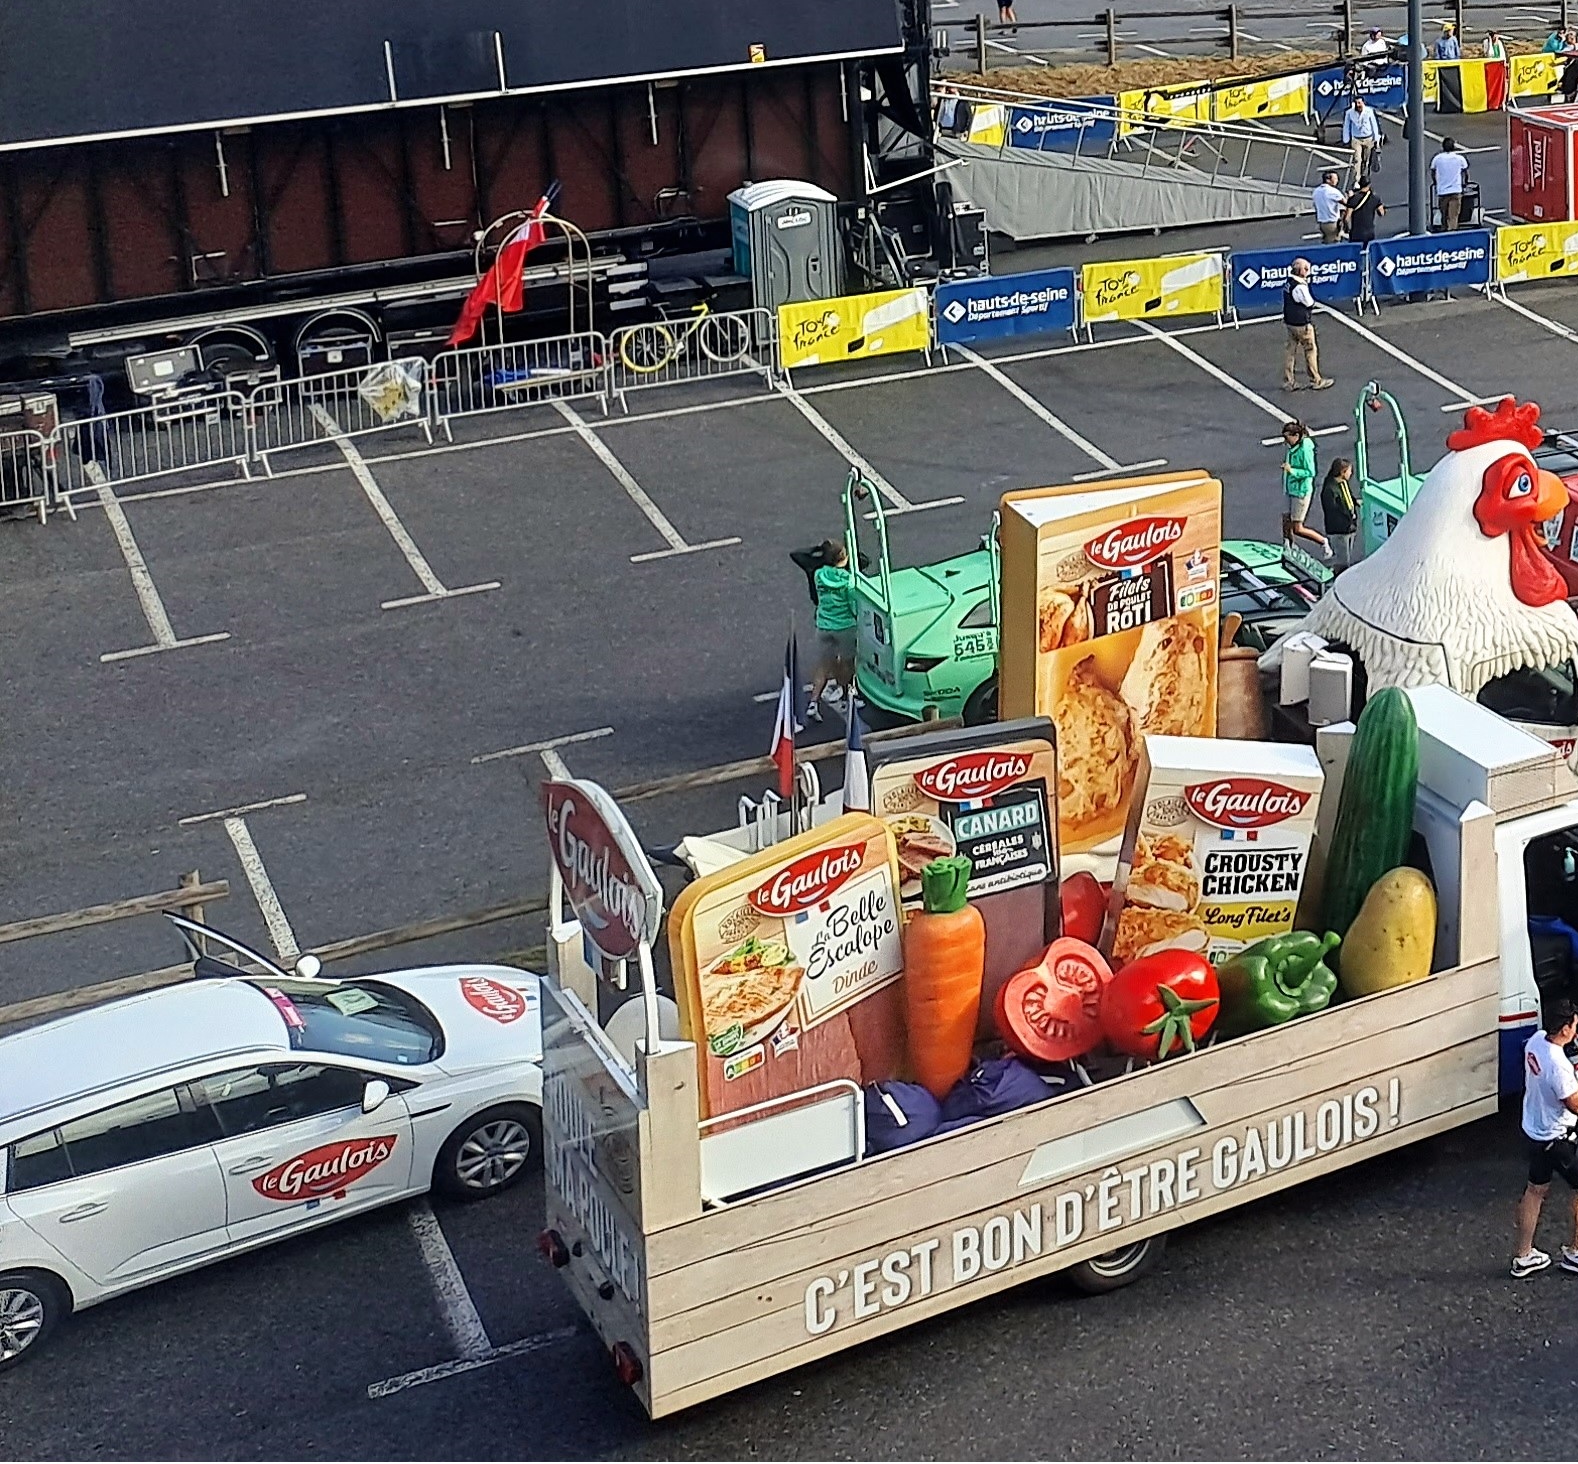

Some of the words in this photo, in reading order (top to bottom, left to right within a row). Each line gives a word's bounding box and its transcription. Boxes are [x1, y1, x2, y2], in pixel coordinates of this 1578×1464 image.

[1090, 539, 1101, 557] le
[1101, 520, 1182, 563] Gaulois
[1108, 575, 1152, 603] Filets
[1106, 600, 1152, 635] RÔTI
[921, 770, 935, 786] le
[935, 755, 1027, 795] Gaulois
[1191, 786, 1205, 803] le
[1204, 782, 1301, 818] Gaulois
[957, 803, 1039, 838] CANARD
[558, 799, 647, 944] Gaulois
[974, 847, 1029, 871] FRANÇAISES
[1204, 852, 1304, 874] CROUSTY
[757, 886, 771, 906] le
[770, 848, 862, 909] Gaulois
[987, 866, 1043, 890] antibiotique
[1202, 872, 1301, 897] CHICKEN
[811, 932, 831, 950] La
[825, 888, 887, 940] Belle
[1203, 907, 1246, 929] Long
[1245, 906, 1291, 926] Filet's
[805, 914, 895, 981] Escalope
[832, 958, 879, 996] Dinde
[262, 1174, 278, 1192] le
[279, 1140, 389, 1196] Gaulois
[804, 1238, 941, 1337] C'EST
[951, 1202, 1043, 1285] BON
[1055, 1148, 1202, 1249] D'ÊTRE
[1210, 1086, 1380, 1191] GAULOIS
